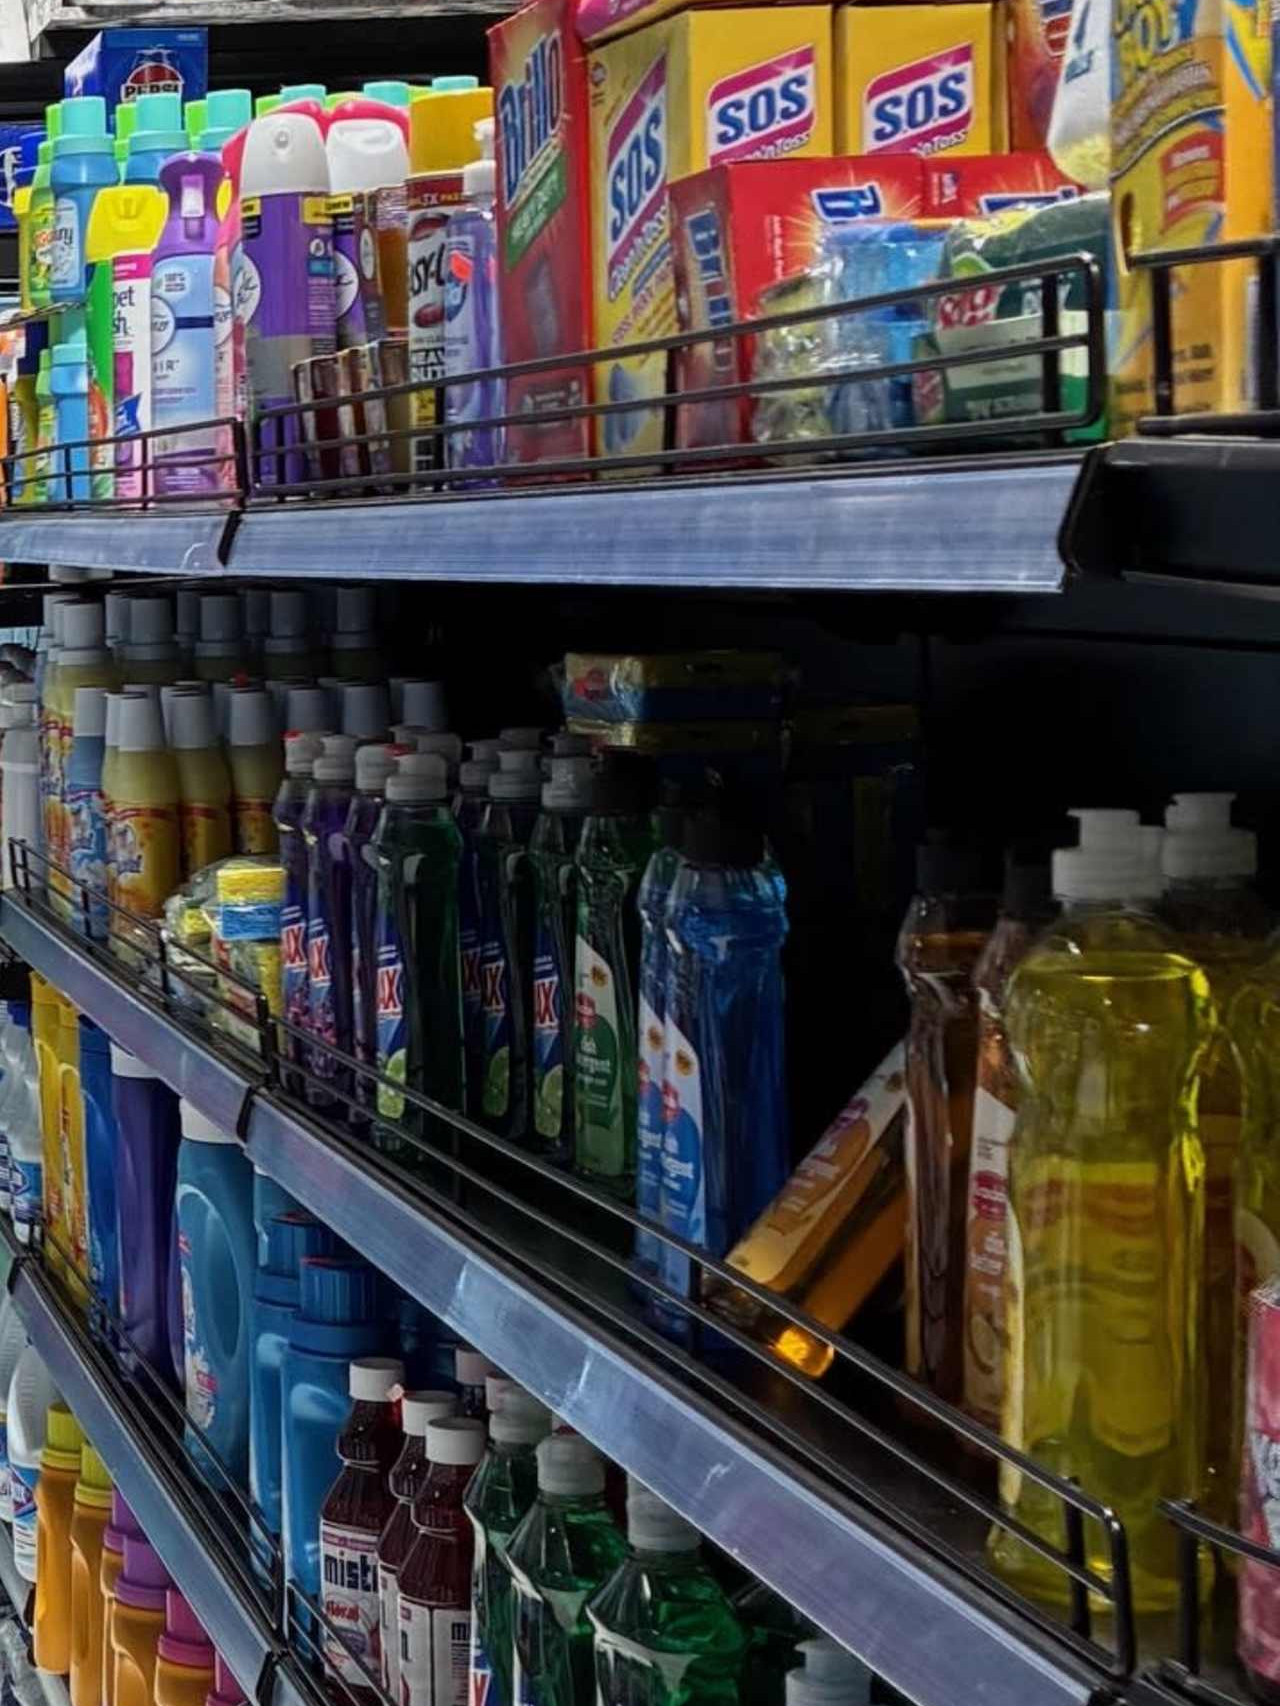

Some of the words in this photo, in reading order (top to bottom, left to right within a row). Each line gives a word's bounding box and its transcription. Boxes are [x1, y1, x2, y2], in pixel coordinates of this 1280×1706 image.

[498, 29, 563, 213] Brillo
[716, 73, 808, 146] S.O.S
[873, 71, 966, 143] S.O.S
